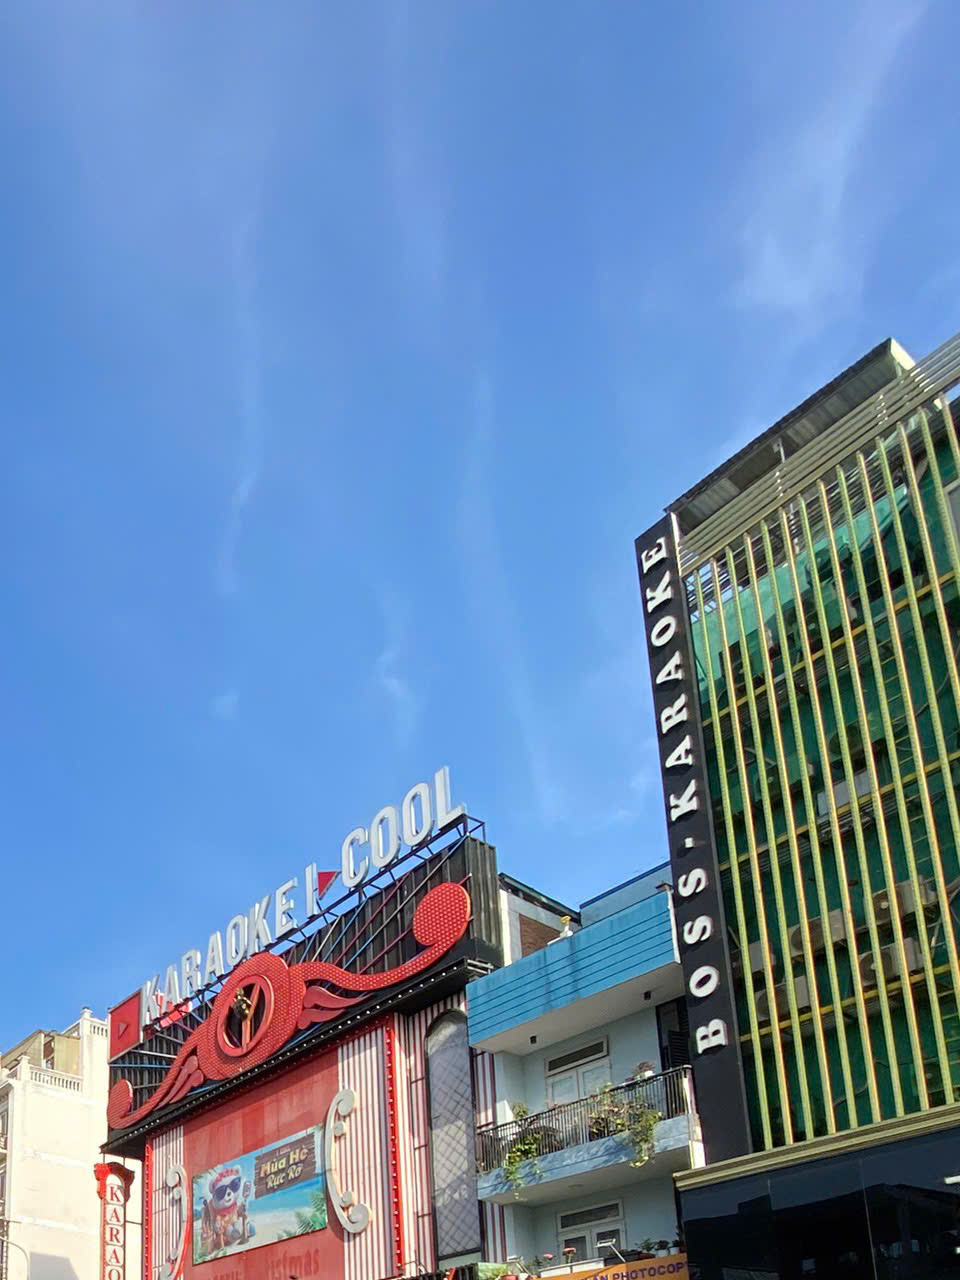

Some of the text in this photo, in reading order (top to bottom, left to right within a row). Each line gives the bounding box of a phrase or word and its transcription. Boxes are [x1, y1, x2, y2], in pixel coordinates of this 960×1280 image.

[641, 537, 698, 822] KARAOKE
[141, 876, 298, 1025] KARAOKE
[341, 765, 468, 890] COOL
[678, 867, 728, 1056] BOSS
